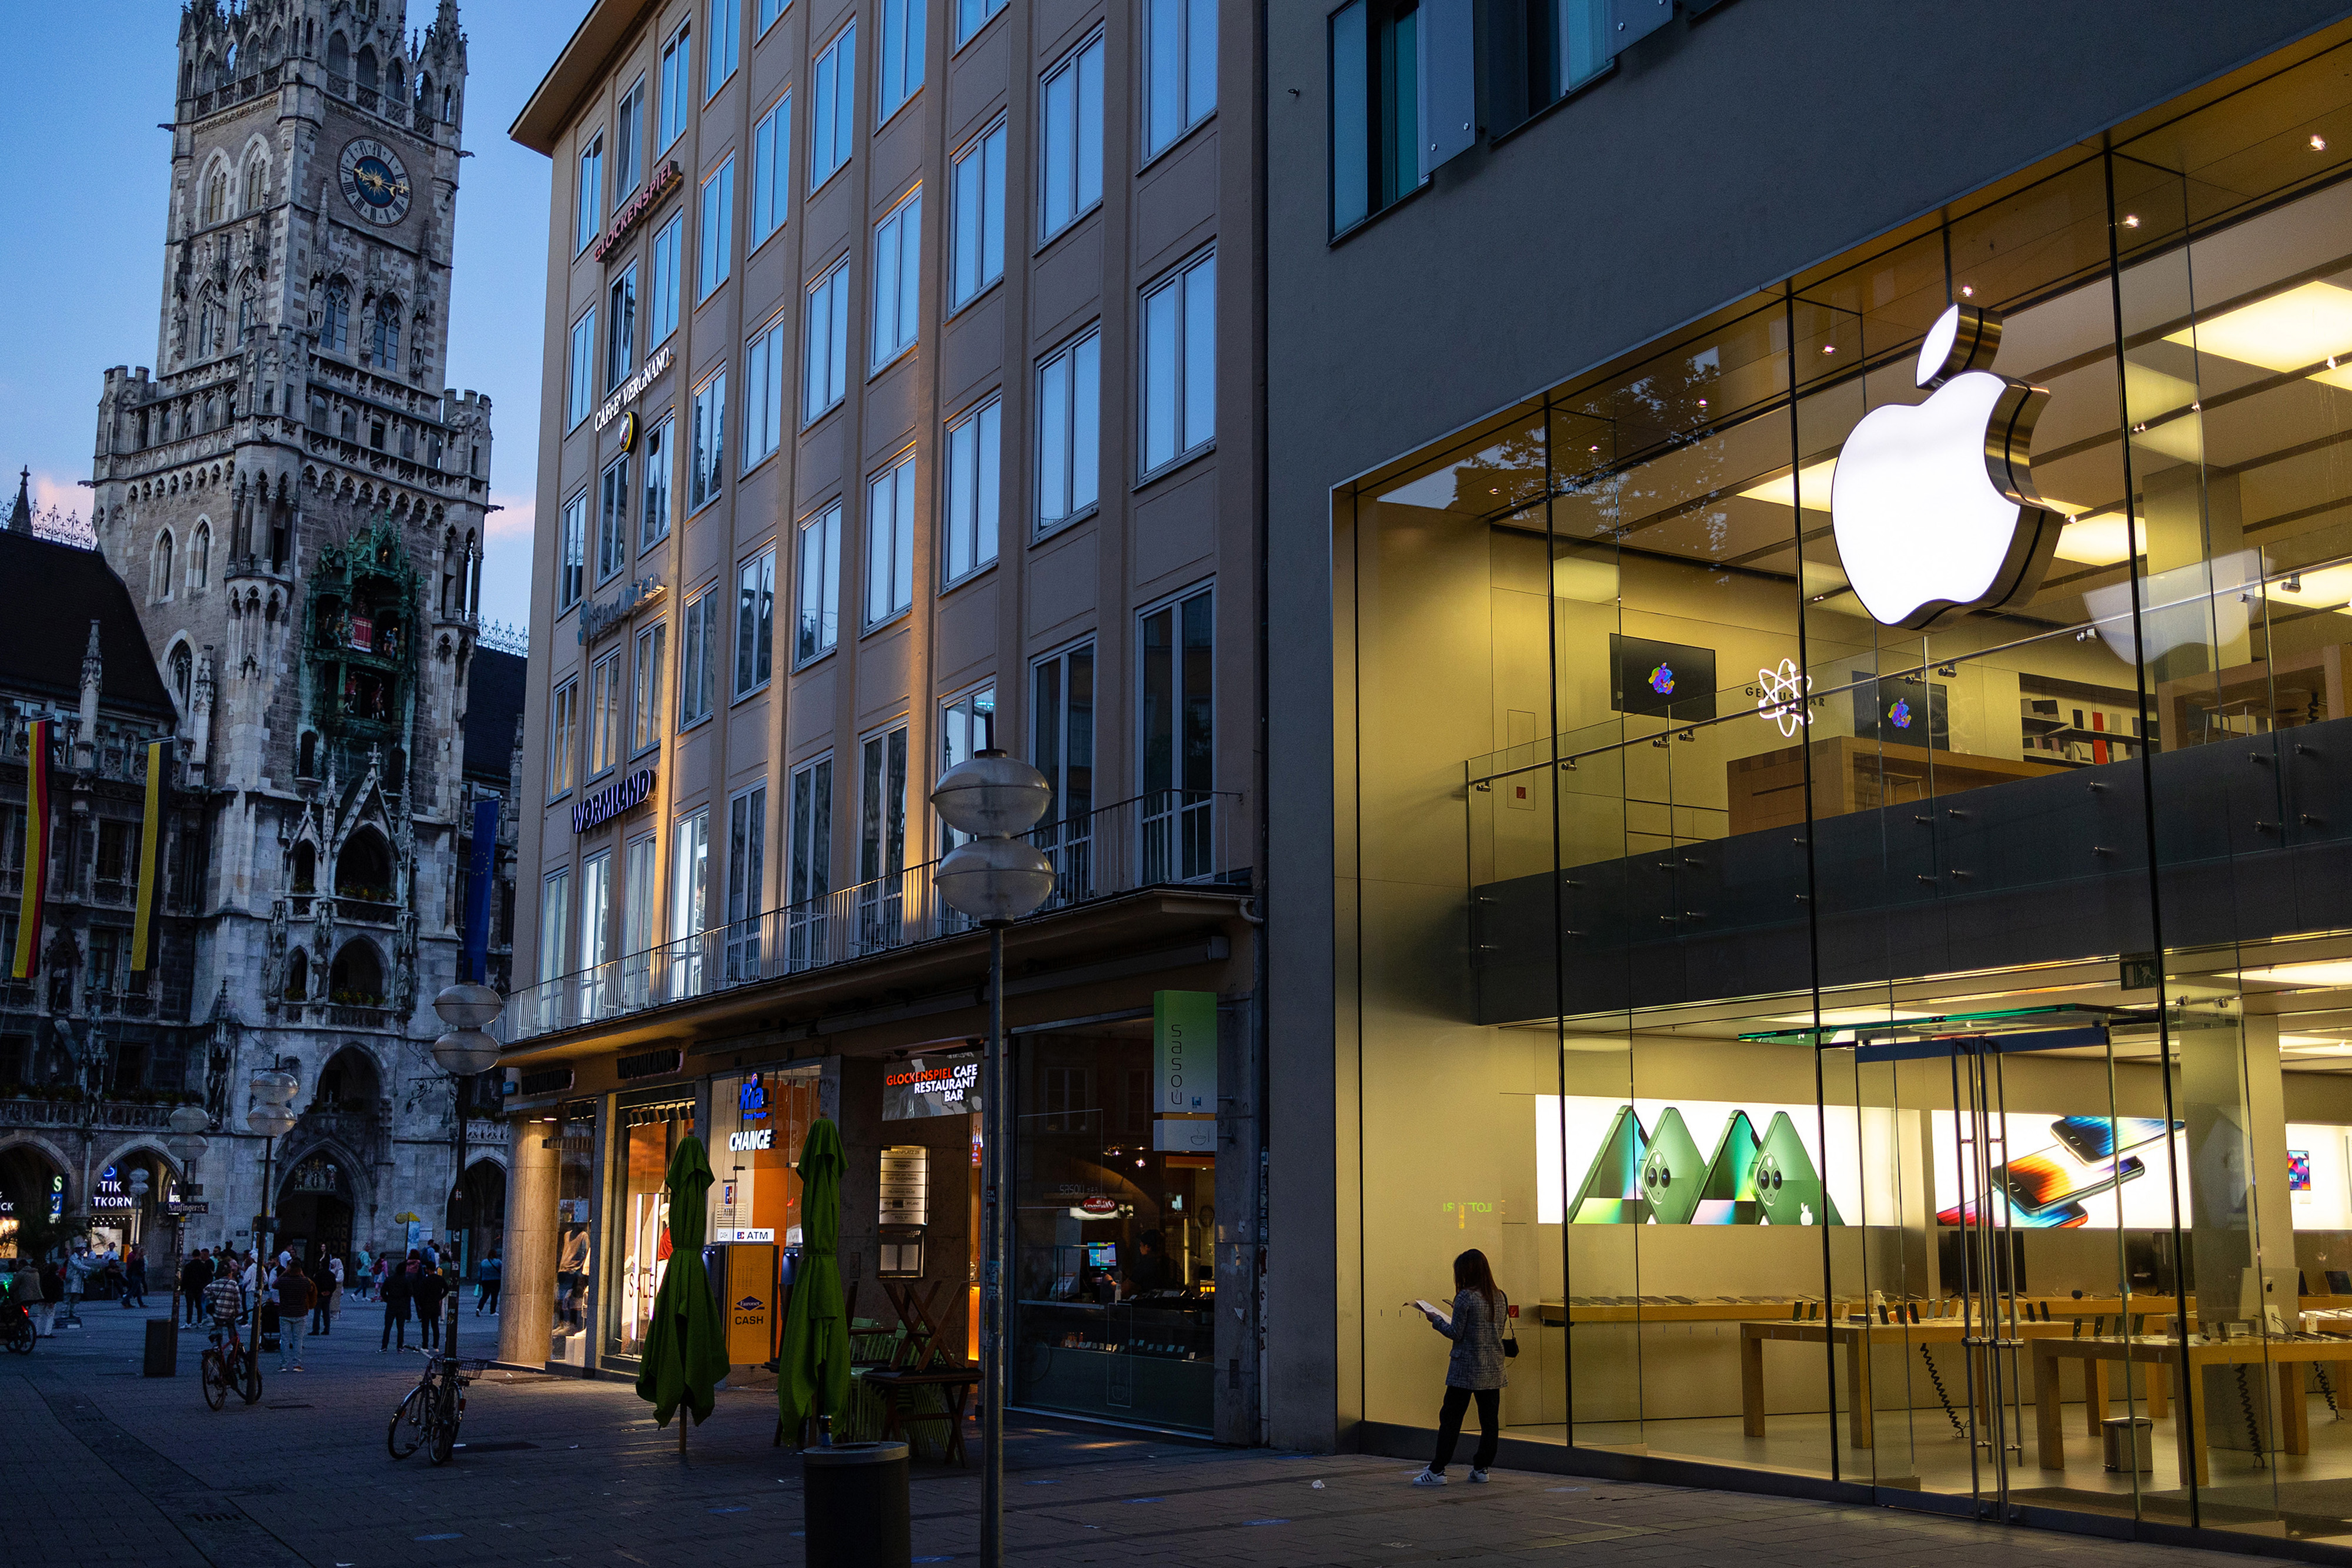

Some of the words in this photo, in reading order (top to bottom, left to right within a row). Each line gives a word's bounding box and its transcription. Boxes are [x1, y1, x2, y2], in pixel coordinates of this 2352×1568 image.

[594, 161, 673, 262] GLOCKENSPIEL
[623, 347, 670, 406] VERGNANO
[1745, 687, 1796, 701] GENUS
[572, 768, 652, 834] WORMLAND
[1171, 1024, 1182, 1105] sasou
[886, 1067, 953, 1086] GLOCKENSPIEL
[953, 1064, 978, 1078] CAFE
[740, 1074, 764, 1110] Ria
[914, 1076, 976, 1094] RESTAURANT
[944, 1089, 964, 1102] BAR
[729, 1128, 773, 1152] CHANGE
[54, 1176, 62, 1192] S
[98, 1181, 122, 1192] TIK
[0, 1202, 14, 1211] CK
[91, 1197, 132, 1206] TKORN
[735, 1316, 764, 1325] CASH
